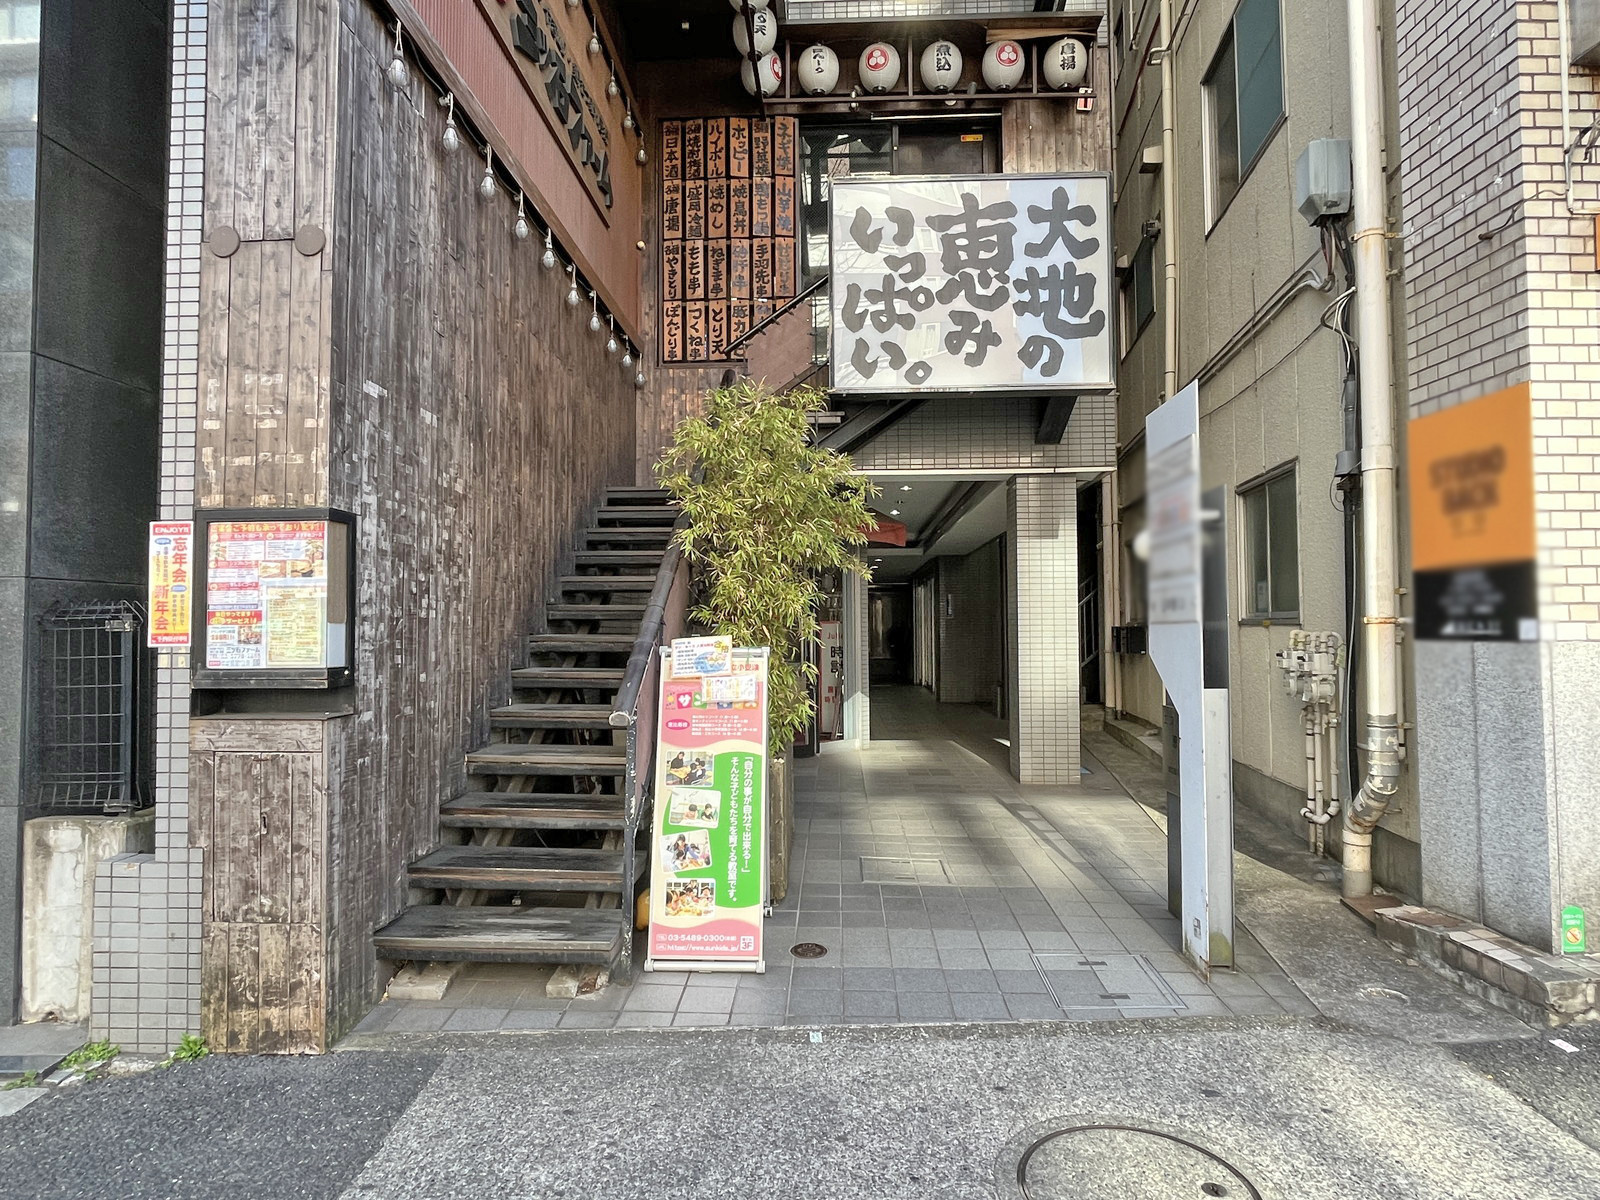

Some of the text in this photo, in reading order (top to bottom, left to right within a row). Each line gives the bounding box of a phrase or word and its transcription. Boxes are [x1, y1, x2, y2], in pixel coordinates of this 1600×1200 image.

[935, 43, 952, 72] 煮込
[1059, 42, 1076, 71] 唐揚
[708, 124, 724, 176] ハイボール
[731, 124, 748, 172] ホッピー
[709, 184, 725, 229] 焼めし
[688, 246, 701, 294] もも串
[710, 246, 725, 297] ねぎま串
[754, 244, 770, 296] 手羽先串
[925, 192, 1018, 367] 恵み
[1012, 186, 1105, 377] 大地の
[841, 206, 935, 385] いっぱい。
[688, 307, 703, 359] つくね串
[711, 308, 724, 354] とり天
[172, 537, 187, 583] 忘年会
[154, 584, 169, 631] 新年会
